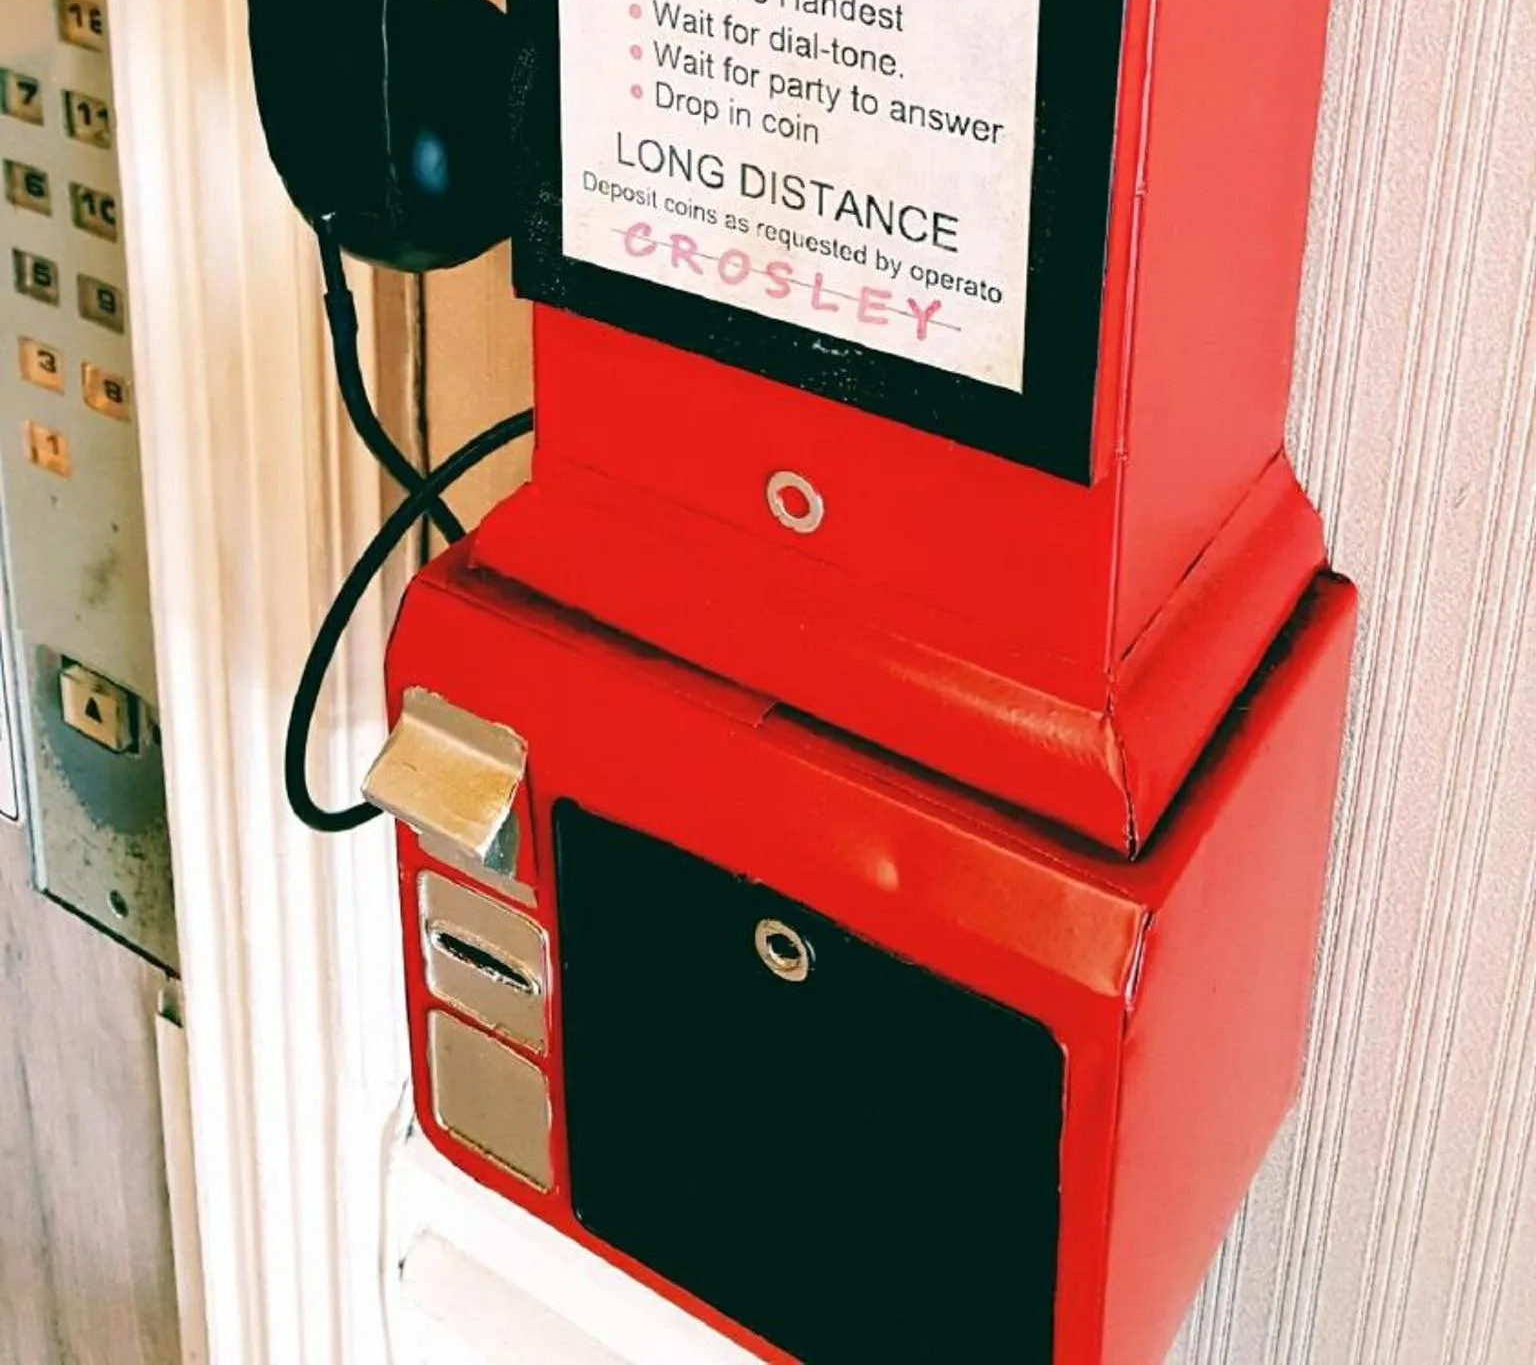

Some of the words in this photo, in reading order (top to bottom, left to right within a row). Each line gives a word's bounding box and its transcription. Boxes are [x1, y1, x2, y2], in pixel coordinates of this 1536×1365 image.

[653, 0, 714, 38] Wait
[723, 15, 760, 47] for
[769, 26, 904, 78] dial-tone.
[17, 81, 38, 106] 7
[653, 40, 714, 80] Wait
[723, 56, 760, 88] for
[769, 72, 840, 113] party
[851, 84, 879, 115] to
[890, 99, 1004, 144] answer
[655, 81, 719, 125] Drop
[728, 98, 752, 128] in
[762, 112, 819, 144] coin
[24, 173, 46, 199] 6
[616, 131, 725, 190] LONG
[740, 163, 959, 253] DISTANCE
[582, 170, 658, 210] Deposit
[664, 194, 718, 226] coins
[725, 211, 750, 233] as
[756, 221, 868, 266] requested
[875, 248, 902, 279] by
[910, 264, 1003, 304] operato
[622, 221, 942, 341] CROSLEY
[37, 349, 57, 374] 3
